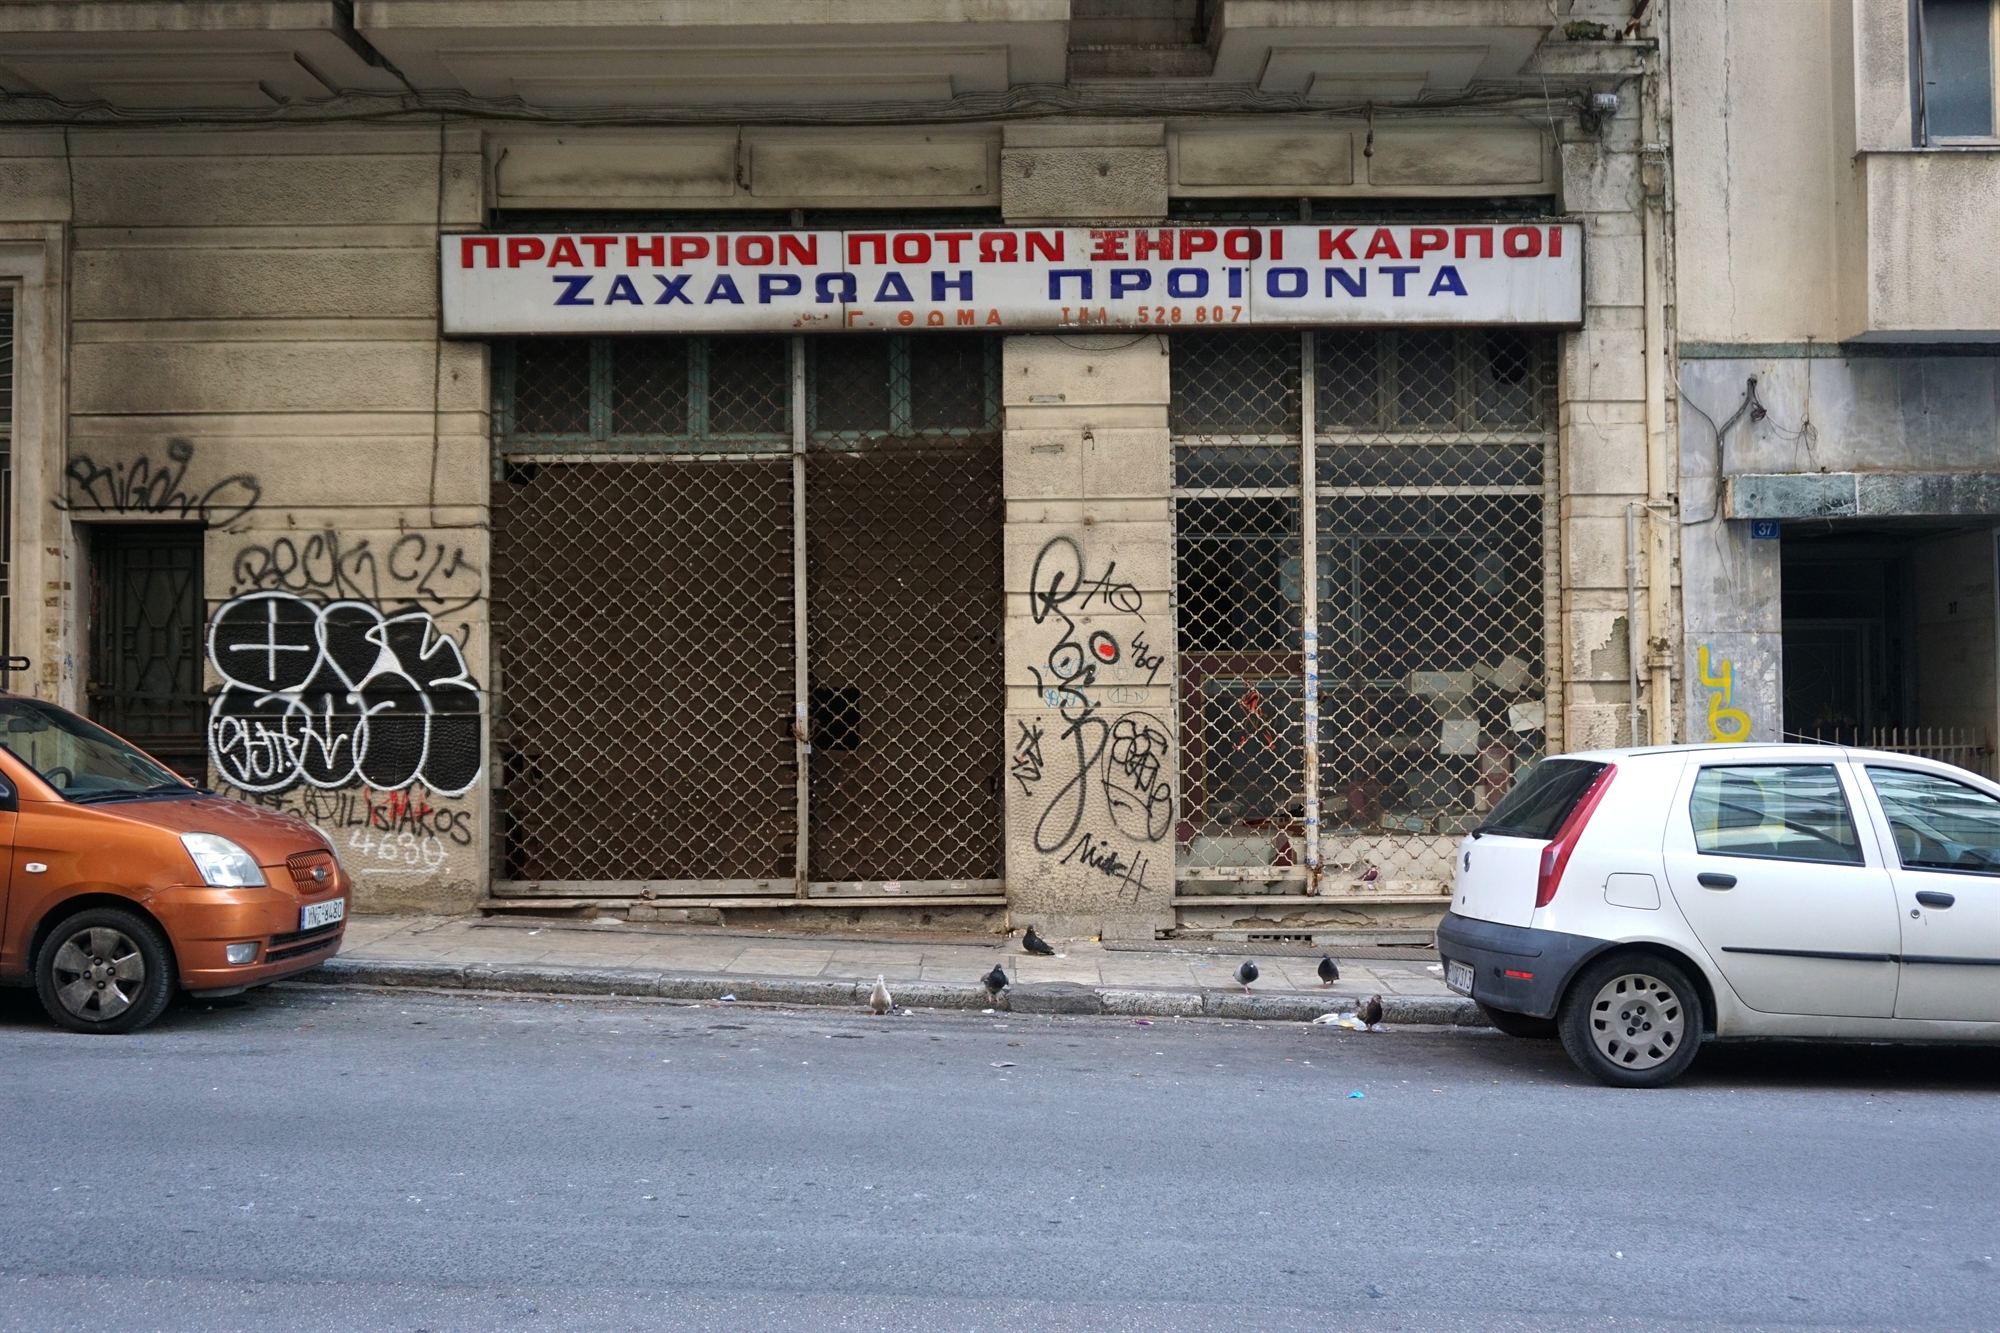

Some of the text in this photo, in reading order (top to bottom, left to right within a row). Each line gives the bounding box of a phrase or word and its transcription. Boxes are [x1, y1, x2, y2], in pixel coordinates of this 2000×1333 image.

[461, 226, 1562, 268] ΠΡΑΤΗΡΙΟΝ ΠΟΤΩΝ ΞΗΡΟΙ ΚΑΡΠΟΙ
[552, 265, 1469, 306] ΖΑΧΑΡΩΔΗ ΠΡΟΪΟΝΤΑ
[847, 311, 875, 327] Γ.
[897, 309, 1002, 326] ΘΩΜΑ
[1138, 306, 1181, 324] 528
[1196, 306, 1242, 323] 807
[1758, 522, 1774, 536] 37
[1948, 601, 1958, 615] 37
